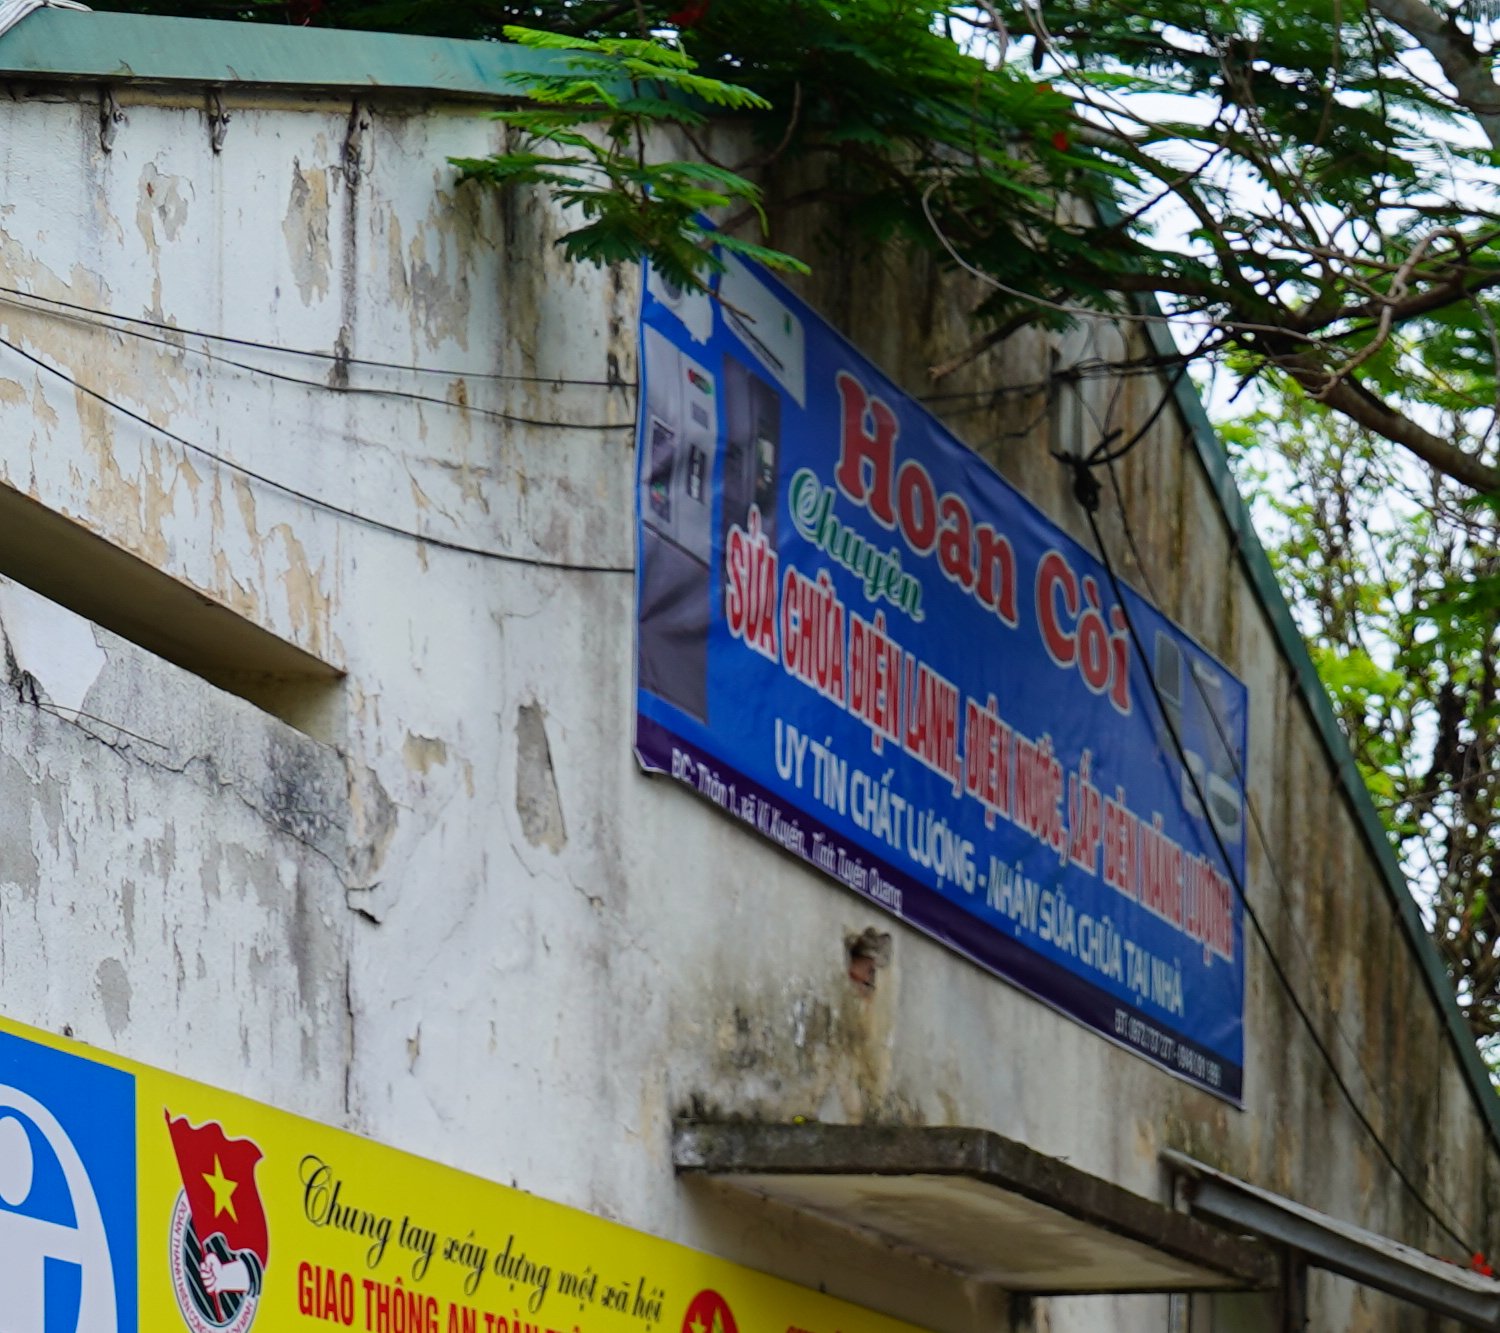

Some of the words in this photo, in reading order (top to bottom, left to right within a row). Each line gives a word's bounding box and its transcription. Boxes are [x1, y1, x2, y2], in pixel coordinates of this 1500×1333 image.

[788, 468, 924, 621] Chuyên
[836, 370, 1019, 628] Hoan
[1036, 549, 1131, 716] Còi
[726, 503, 779, 663] SỬA
[782, 563, 846, 709] CHỮA
[848, 609, 902, 756] ĐIỆN
[966, 694, 1012, 830] ĐIỆN
[775, 717, 809, 789] UY
[810, 735, 848, 816] TÍN
[850, 768, 907, 850] CHẤT
[906, 806, 976, 895] LƯỢNG
[987, 856, 1038, 937] NHẬN
[1038, 883, 1077, 957] SỬA
[297, 1261, 355, 1328] GIAO
[298, 1153, 393, 1270] Chung
[398, 1214, 437, 1283] tay
[443, 1229, 489, 1297] xây
[493, 1234, 552, 1315] dựng
[557, 1266, 599, 1313] một
[601, 1279, 630, 1314] xã
[632, 1276, 666, 1332] hội
